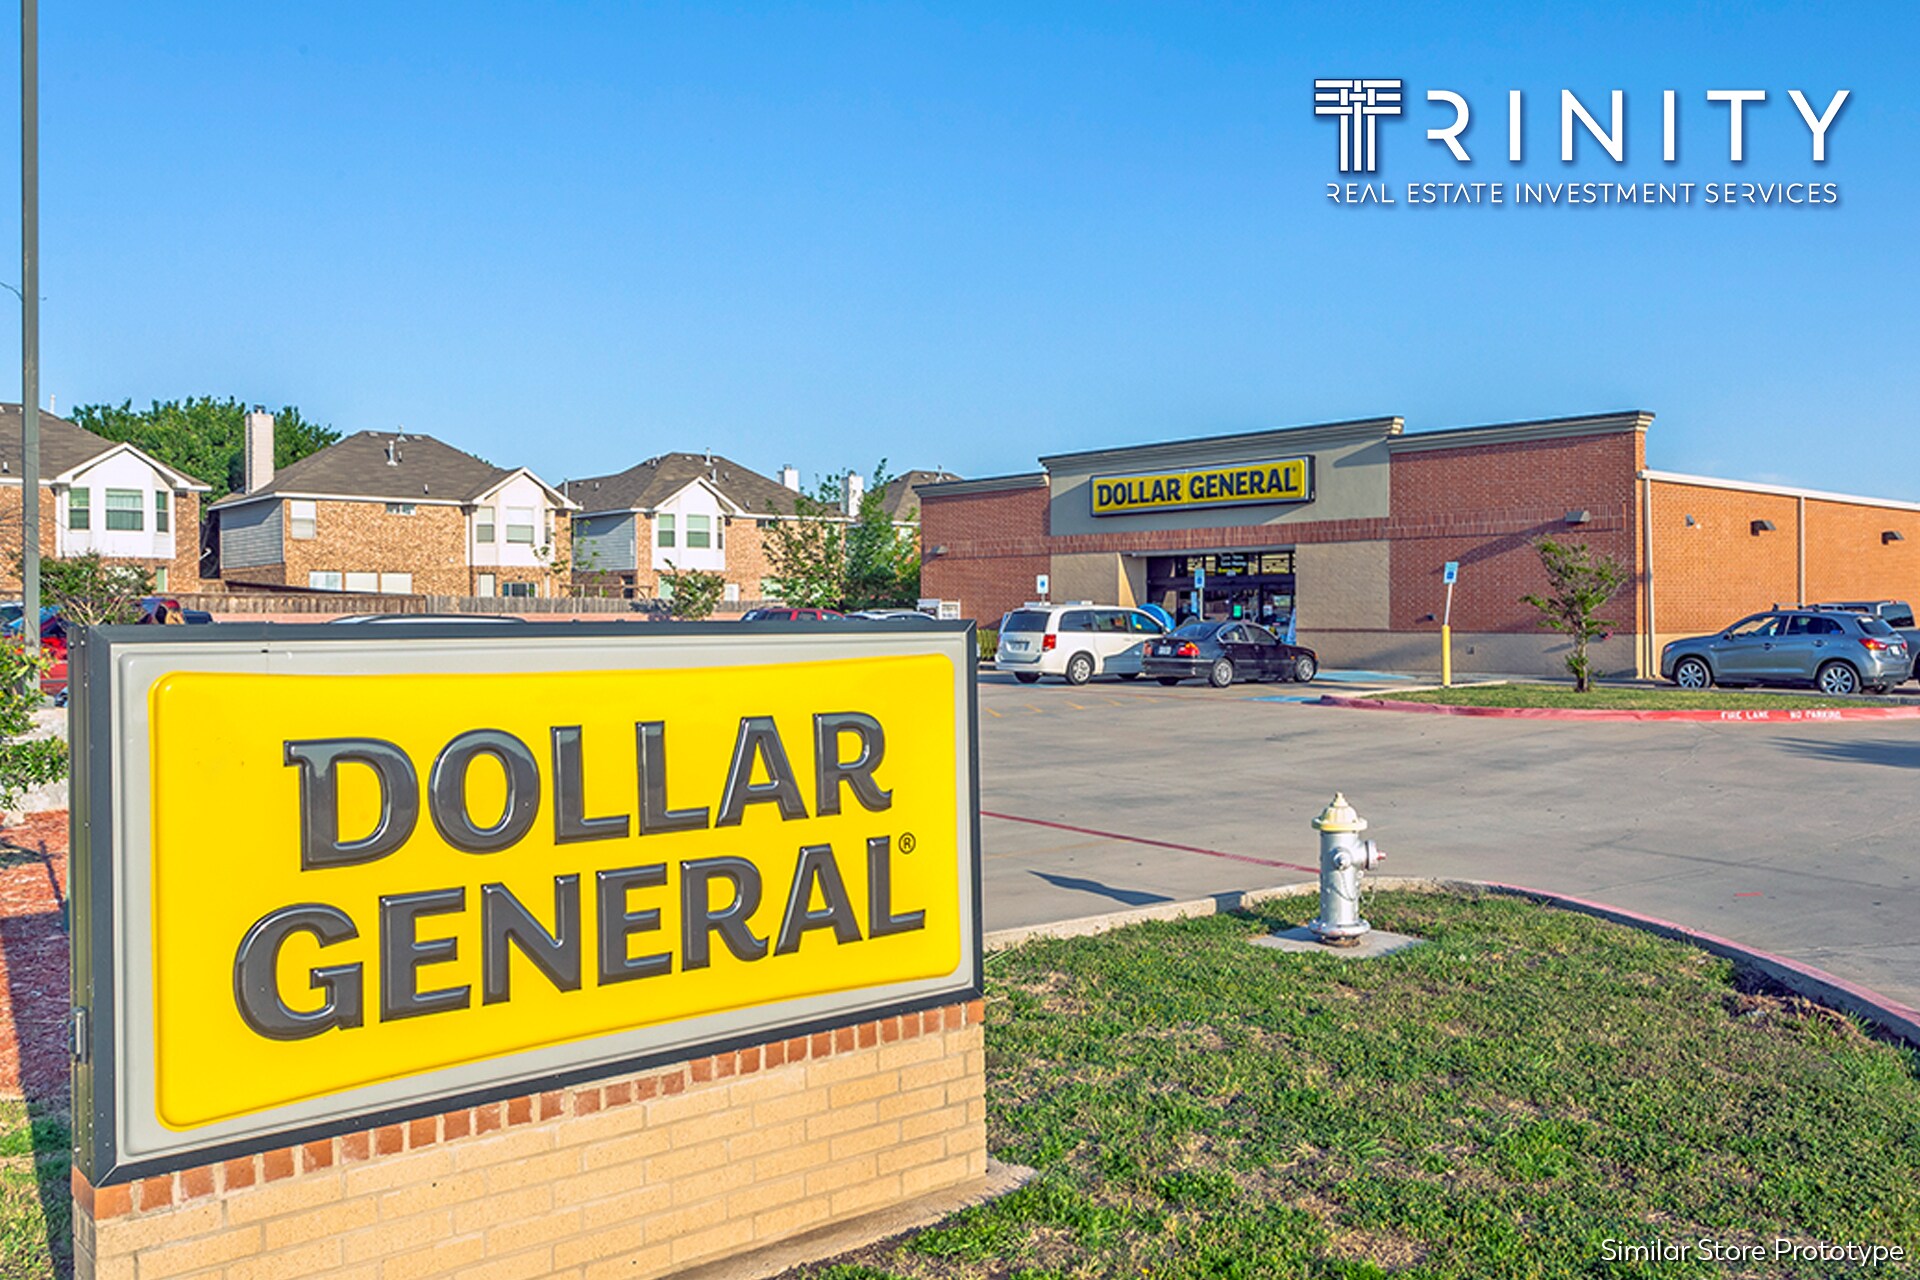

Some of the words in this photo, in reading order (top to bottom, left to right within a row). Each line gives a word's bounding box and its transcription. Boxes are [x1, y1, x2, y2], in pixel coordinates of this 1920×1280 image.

[1097, 478, 1182, 507] DOLLAR
[1189, 467, 1298, 500] GENERAL
[283, 710, 894, 873] DOLLAR
[233, 834, 926, 1041] GENERAL
